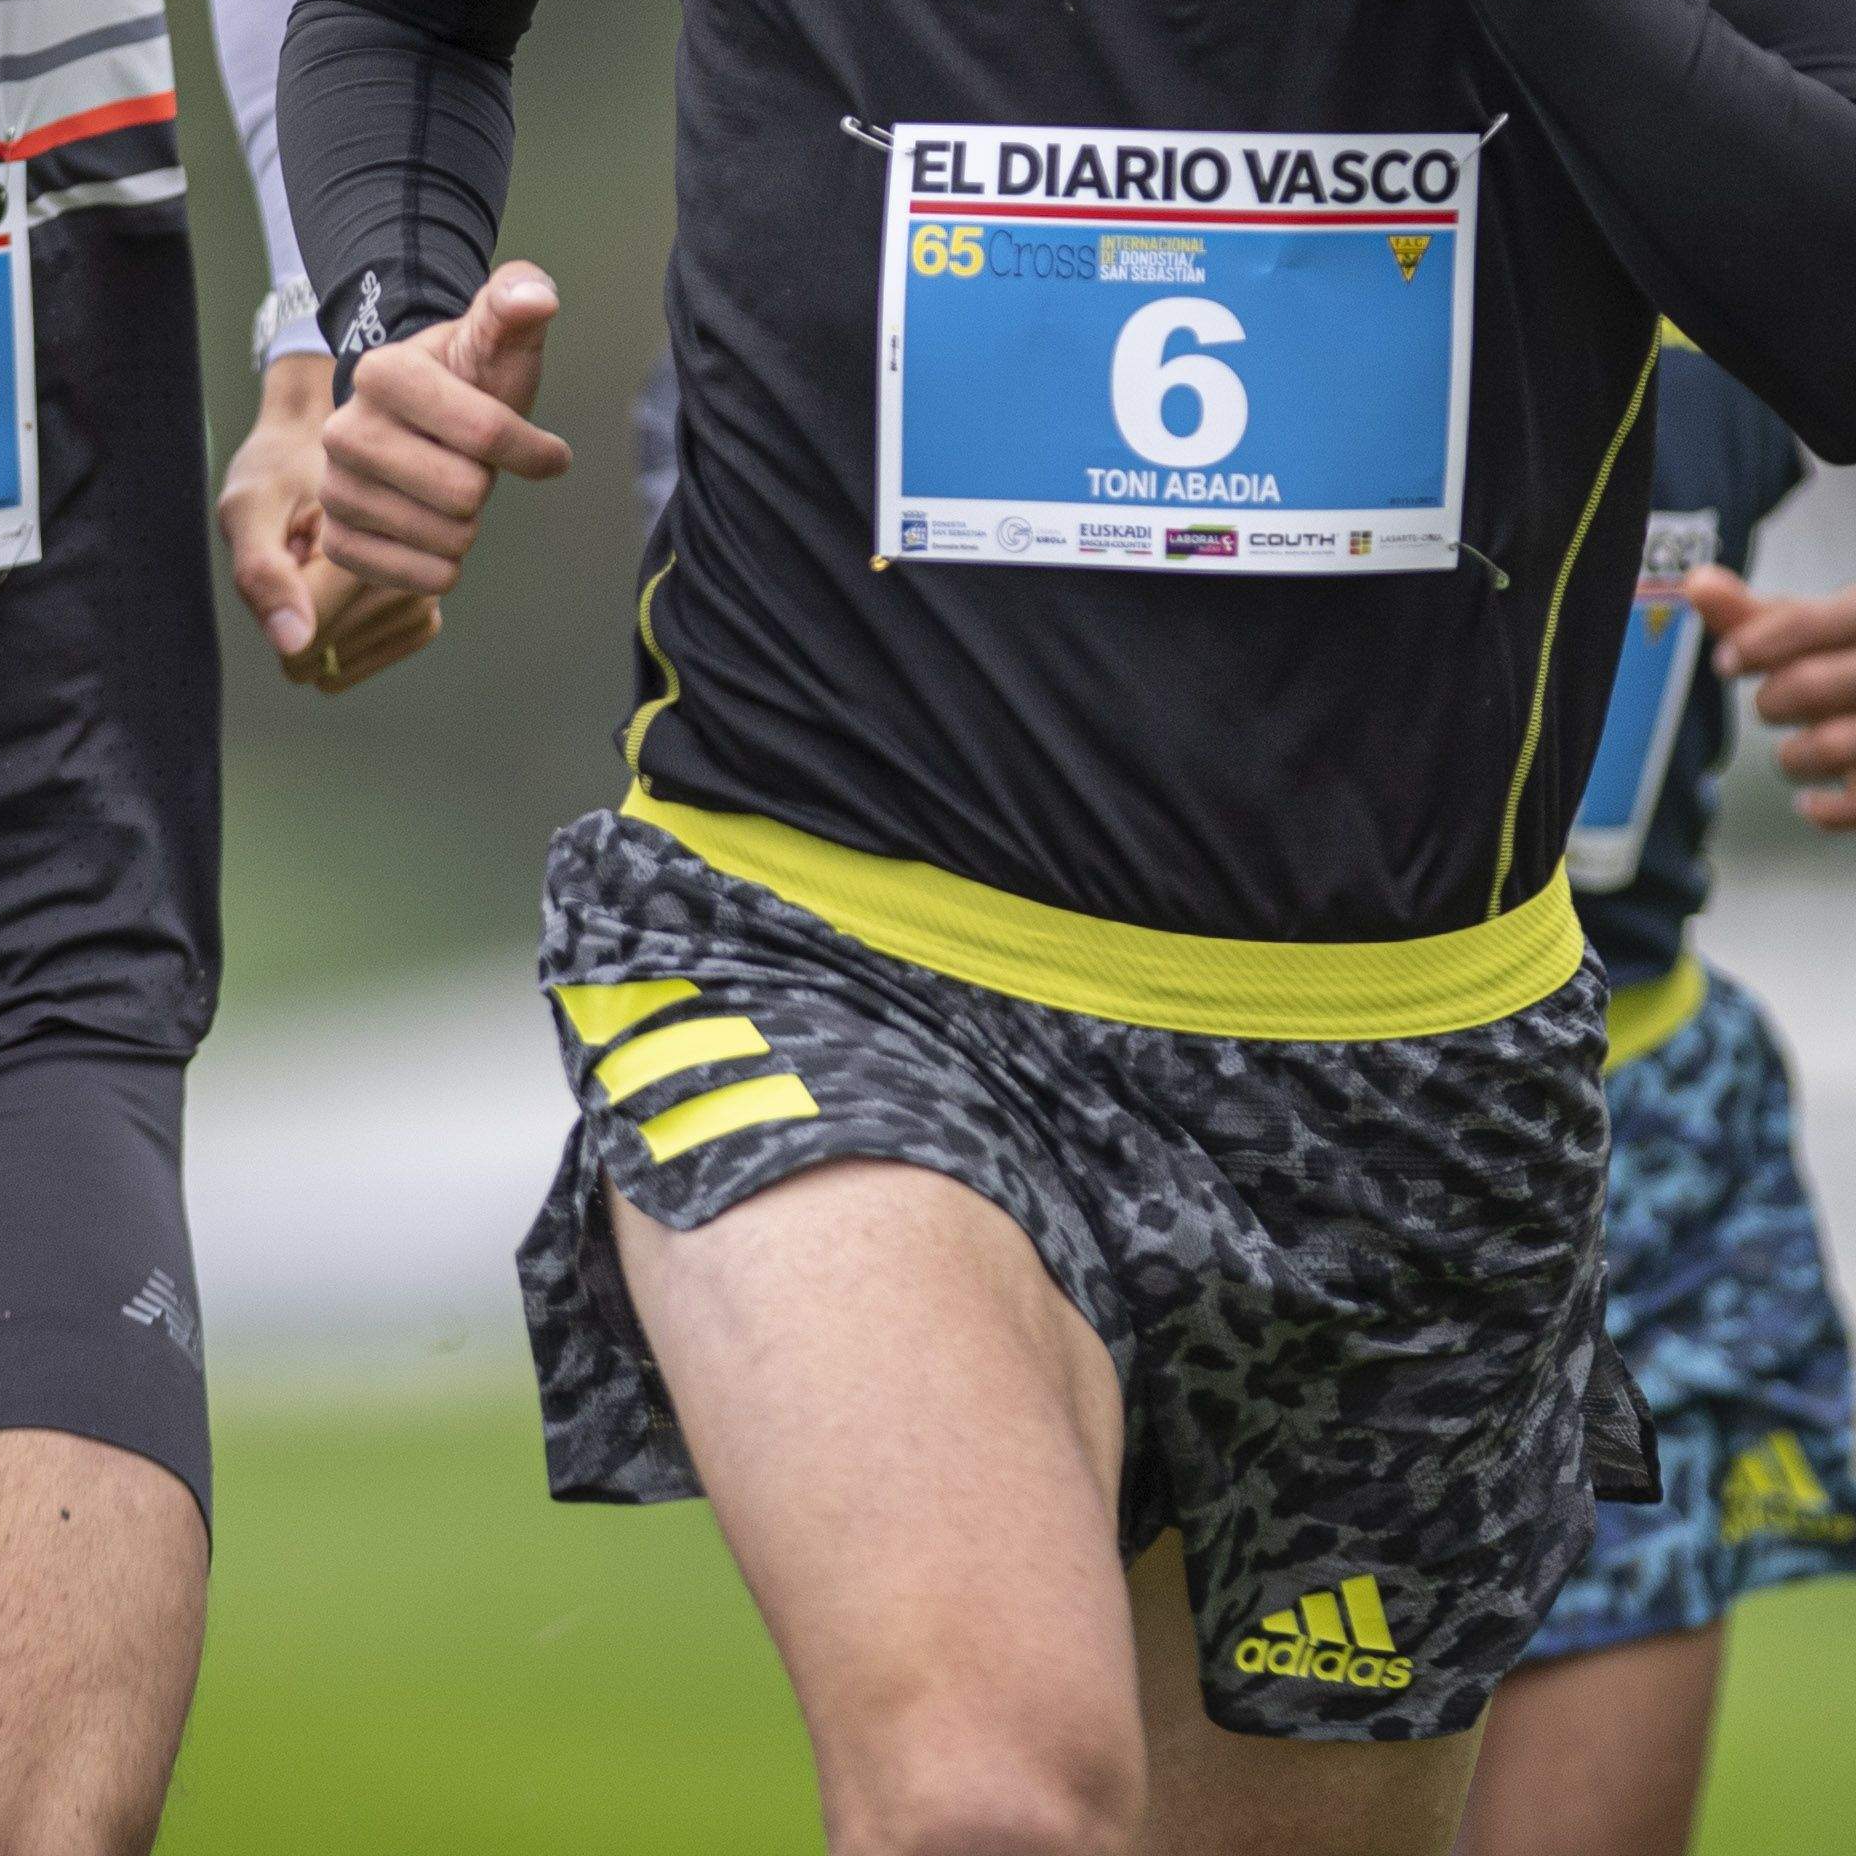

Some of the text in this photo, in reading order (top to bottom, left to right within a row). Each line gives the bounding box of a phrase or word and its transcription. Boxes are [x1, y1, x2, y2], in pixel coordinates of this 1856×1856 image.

[911, 140, 1461, 204] EL DIARIO VASCO
[912, 224, 1095, 279] 65 Cross
[1111, 295, 1248, 470] 6
[1087, 467, 1281, 504] TONI ABADIA
[1080, 522, 1152, 539] EUSKADI
[1249, 532, 1336, 546] COUTH
[1234, 1634, 1414, 1690] adidas
